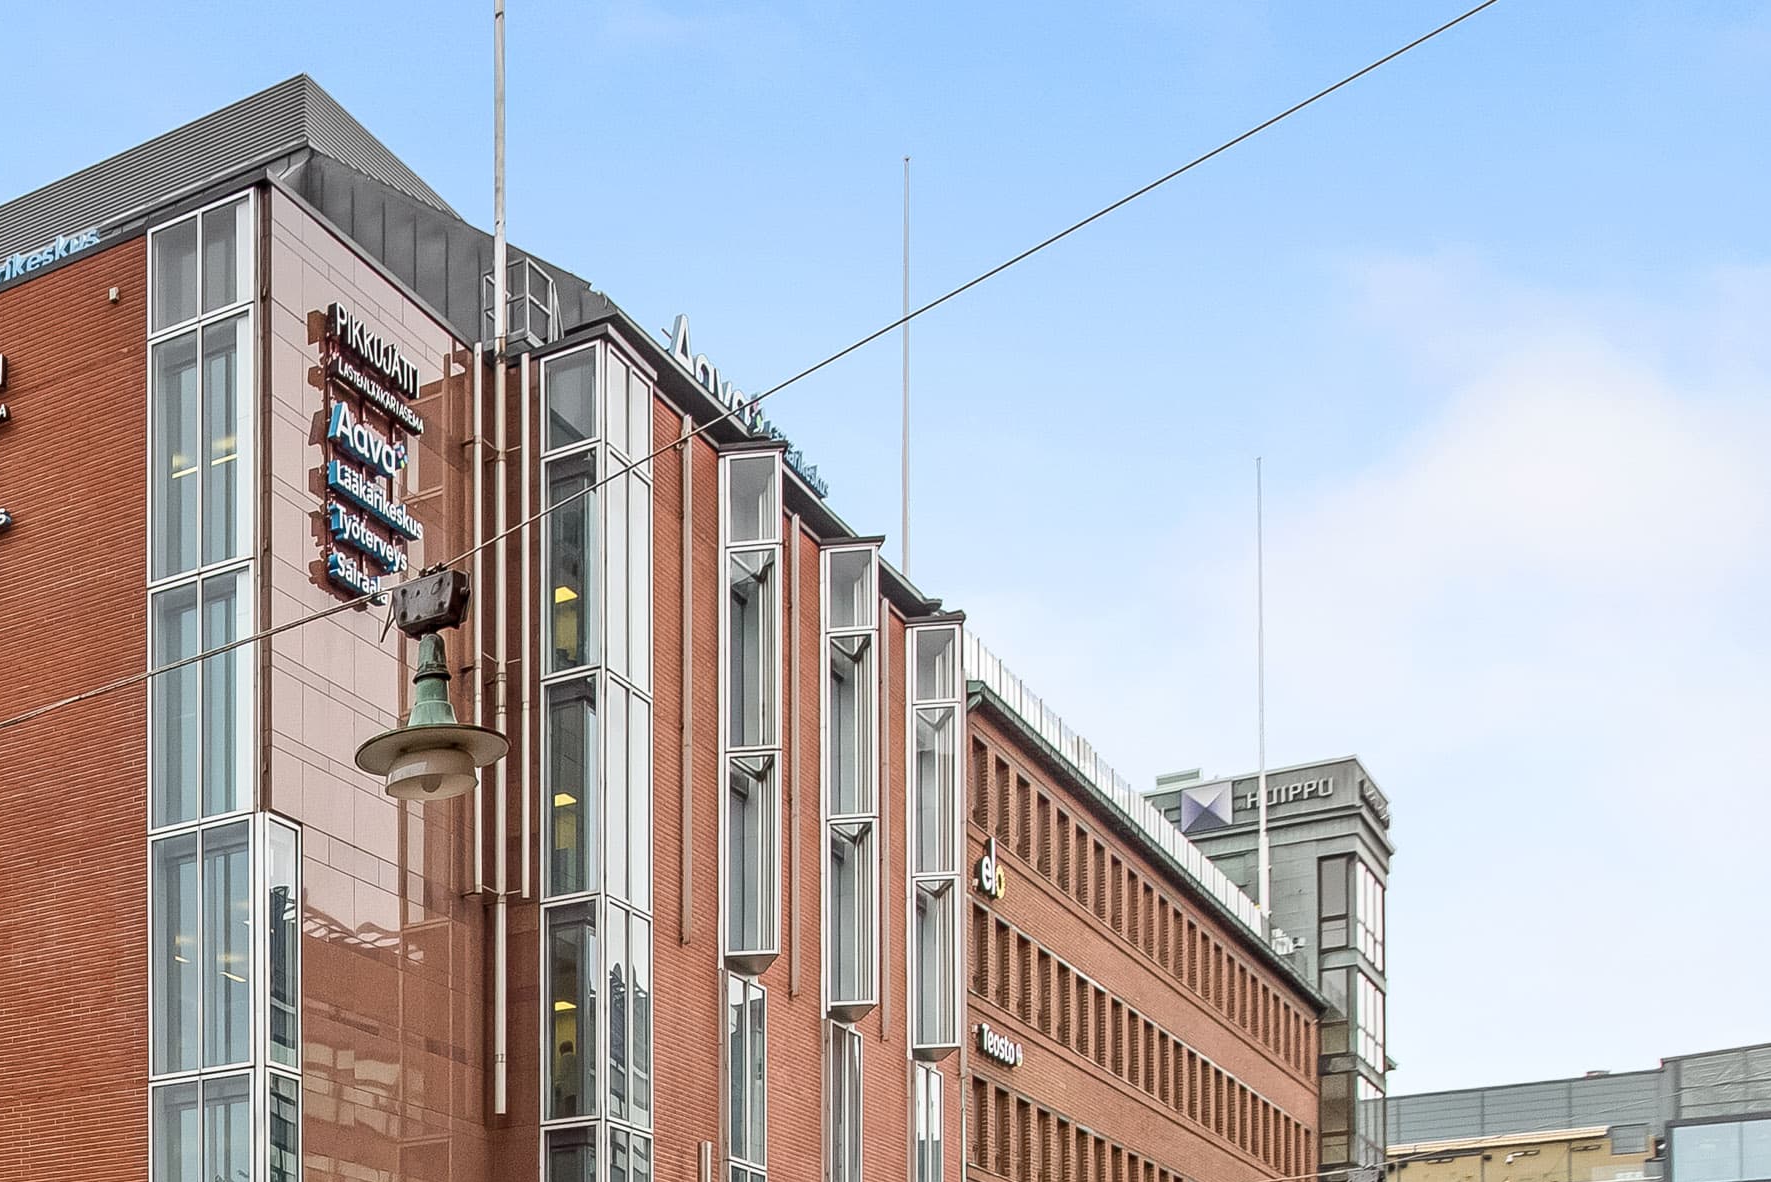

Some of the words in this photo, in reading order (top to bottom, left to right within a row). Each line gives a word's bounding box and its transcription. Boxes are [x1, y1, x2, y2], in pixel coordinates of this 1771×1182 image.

[335, 302, 420, 399] PIKKUJÄTTI
[337, 355, 425, 434] LASTENLÄÄKÄRIASEMA
[335, 400, 397, 478] Aava
[335, 458, 424, 541] Lääkärikeskus
[336, 504, 408, 573] Työterveys
[981, 836, 1007, 900] elo
[981, 1022, 1016, 1066] Teosto
